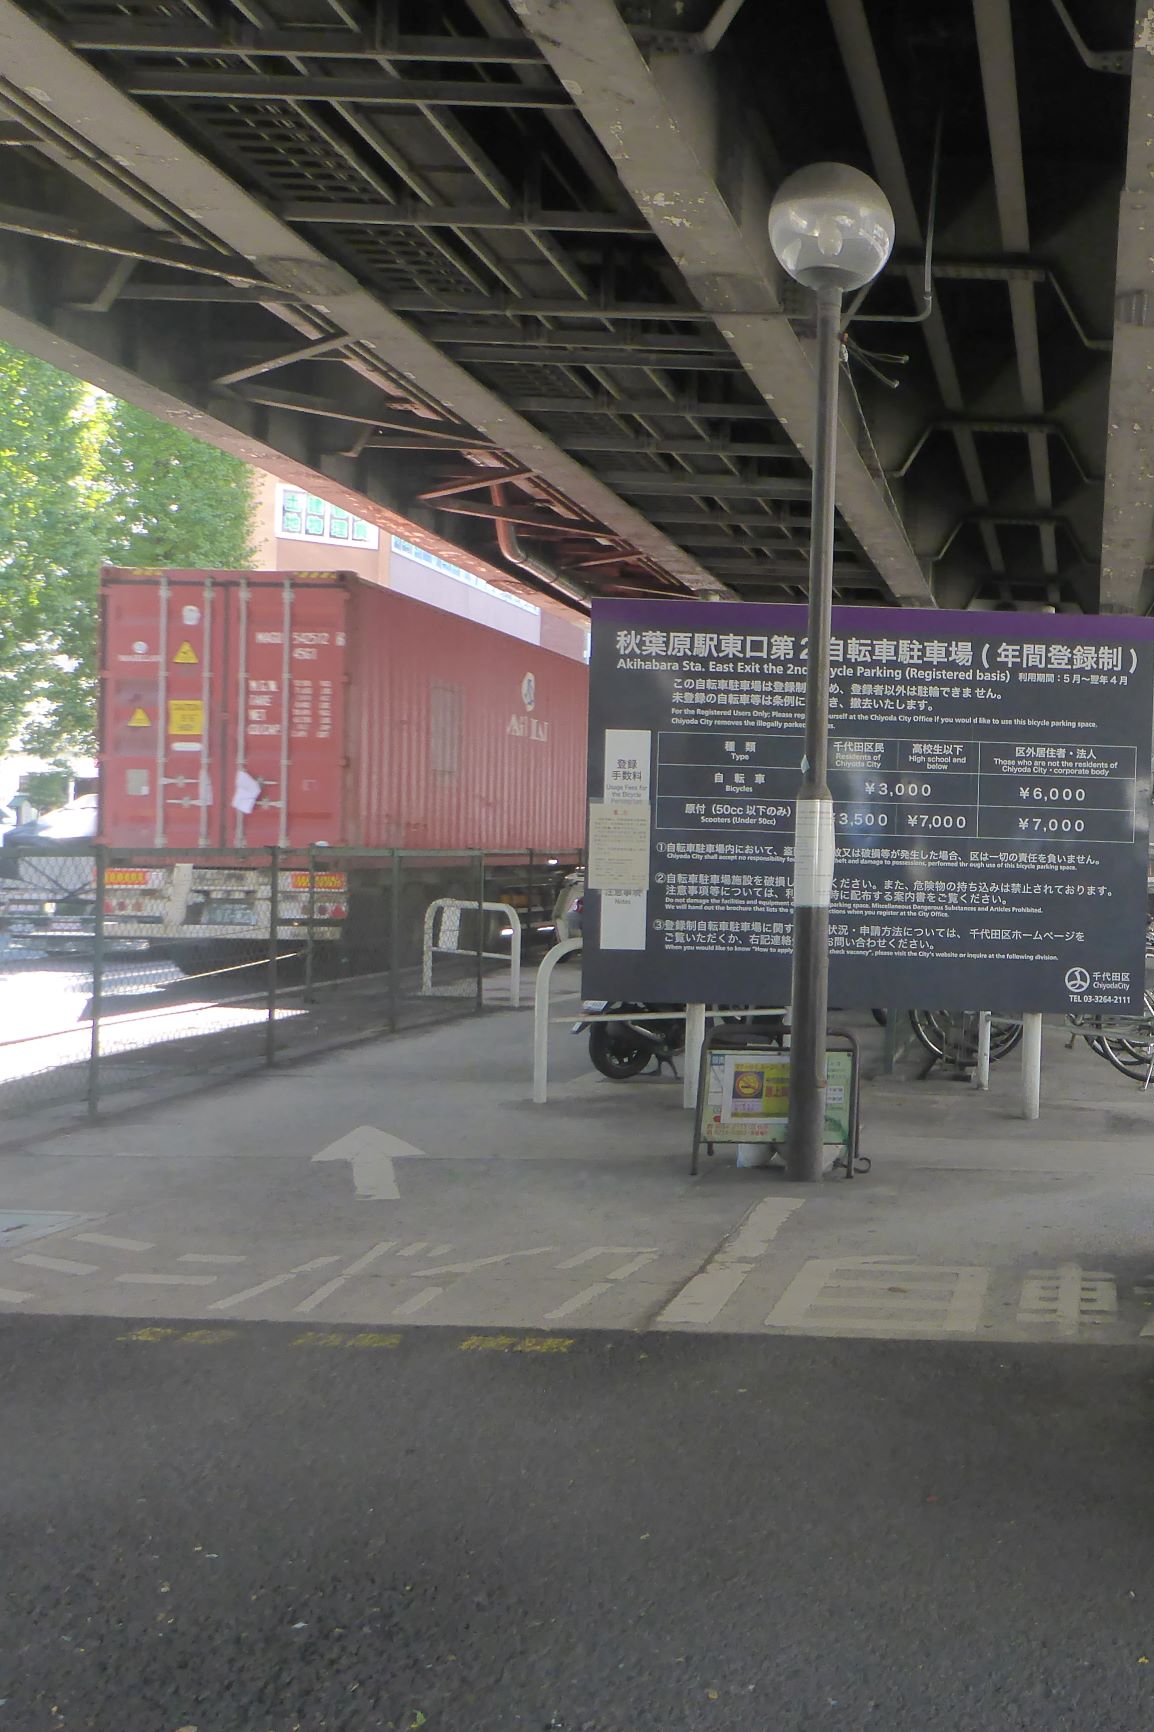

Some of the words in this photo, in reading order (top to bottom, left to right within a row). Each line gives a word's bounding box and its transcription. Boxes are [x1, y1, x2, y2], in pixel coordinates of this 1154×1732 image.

[617, 659, 679, 671] Akihabara
[682, 660, 704, 672] Sta.
[709, 661, 733, 673] East
[737, 662, 760, 673] Exit
[763, 662, 783, 674] the
[829, 664, 853, 679] ycle
[856, 665, 901, 680] Parking
[905, 666, 972, 682] (Registered
[976, 668, 1010, 683] basis)
[673, 679, 1002, 699] この自転車駐車場は登録制め、登録者以外は駐輪できません。
[672, 692, 933, 711] 未登録の自転車等は条例にき、撤去いたします。
[829, 712, 847, 720] urself
[833, 741, 885, 753] 千代田区民
[912, 743, 964, 755] 高校生以下
[731, 752, 749, 761] Type
[909, 755, 925, 763] High
[616, 759, 638, 769] 登録
[866, 761, 881, 769] City
[1075, 761, 1109, 769] residents
[611, 770, 642, 781] 手数料
[1002, 766, 1031, 774] Chiyoda
[1033, 766, 1047, 774] City
[1091, 769, 1110, 777] body
[714, 772, 766, 784] 自転車
[725, 785, 753, 793] Bicycles
[865, 783, 932, 797] ¥3,000
[1019, 787, 1086, 801] ¥6,000
[700, 816, 731, 824] Scooters
[907, 815, 966, 829] ¥7,000
[1018, 818, 1085, 832] ¥7,000
[1092, 972, 1130, 982] 千代田区
[1069, 994, 1082, 1002] TEL
[1083, 995, 1131, 1004] 03-3264-2111
